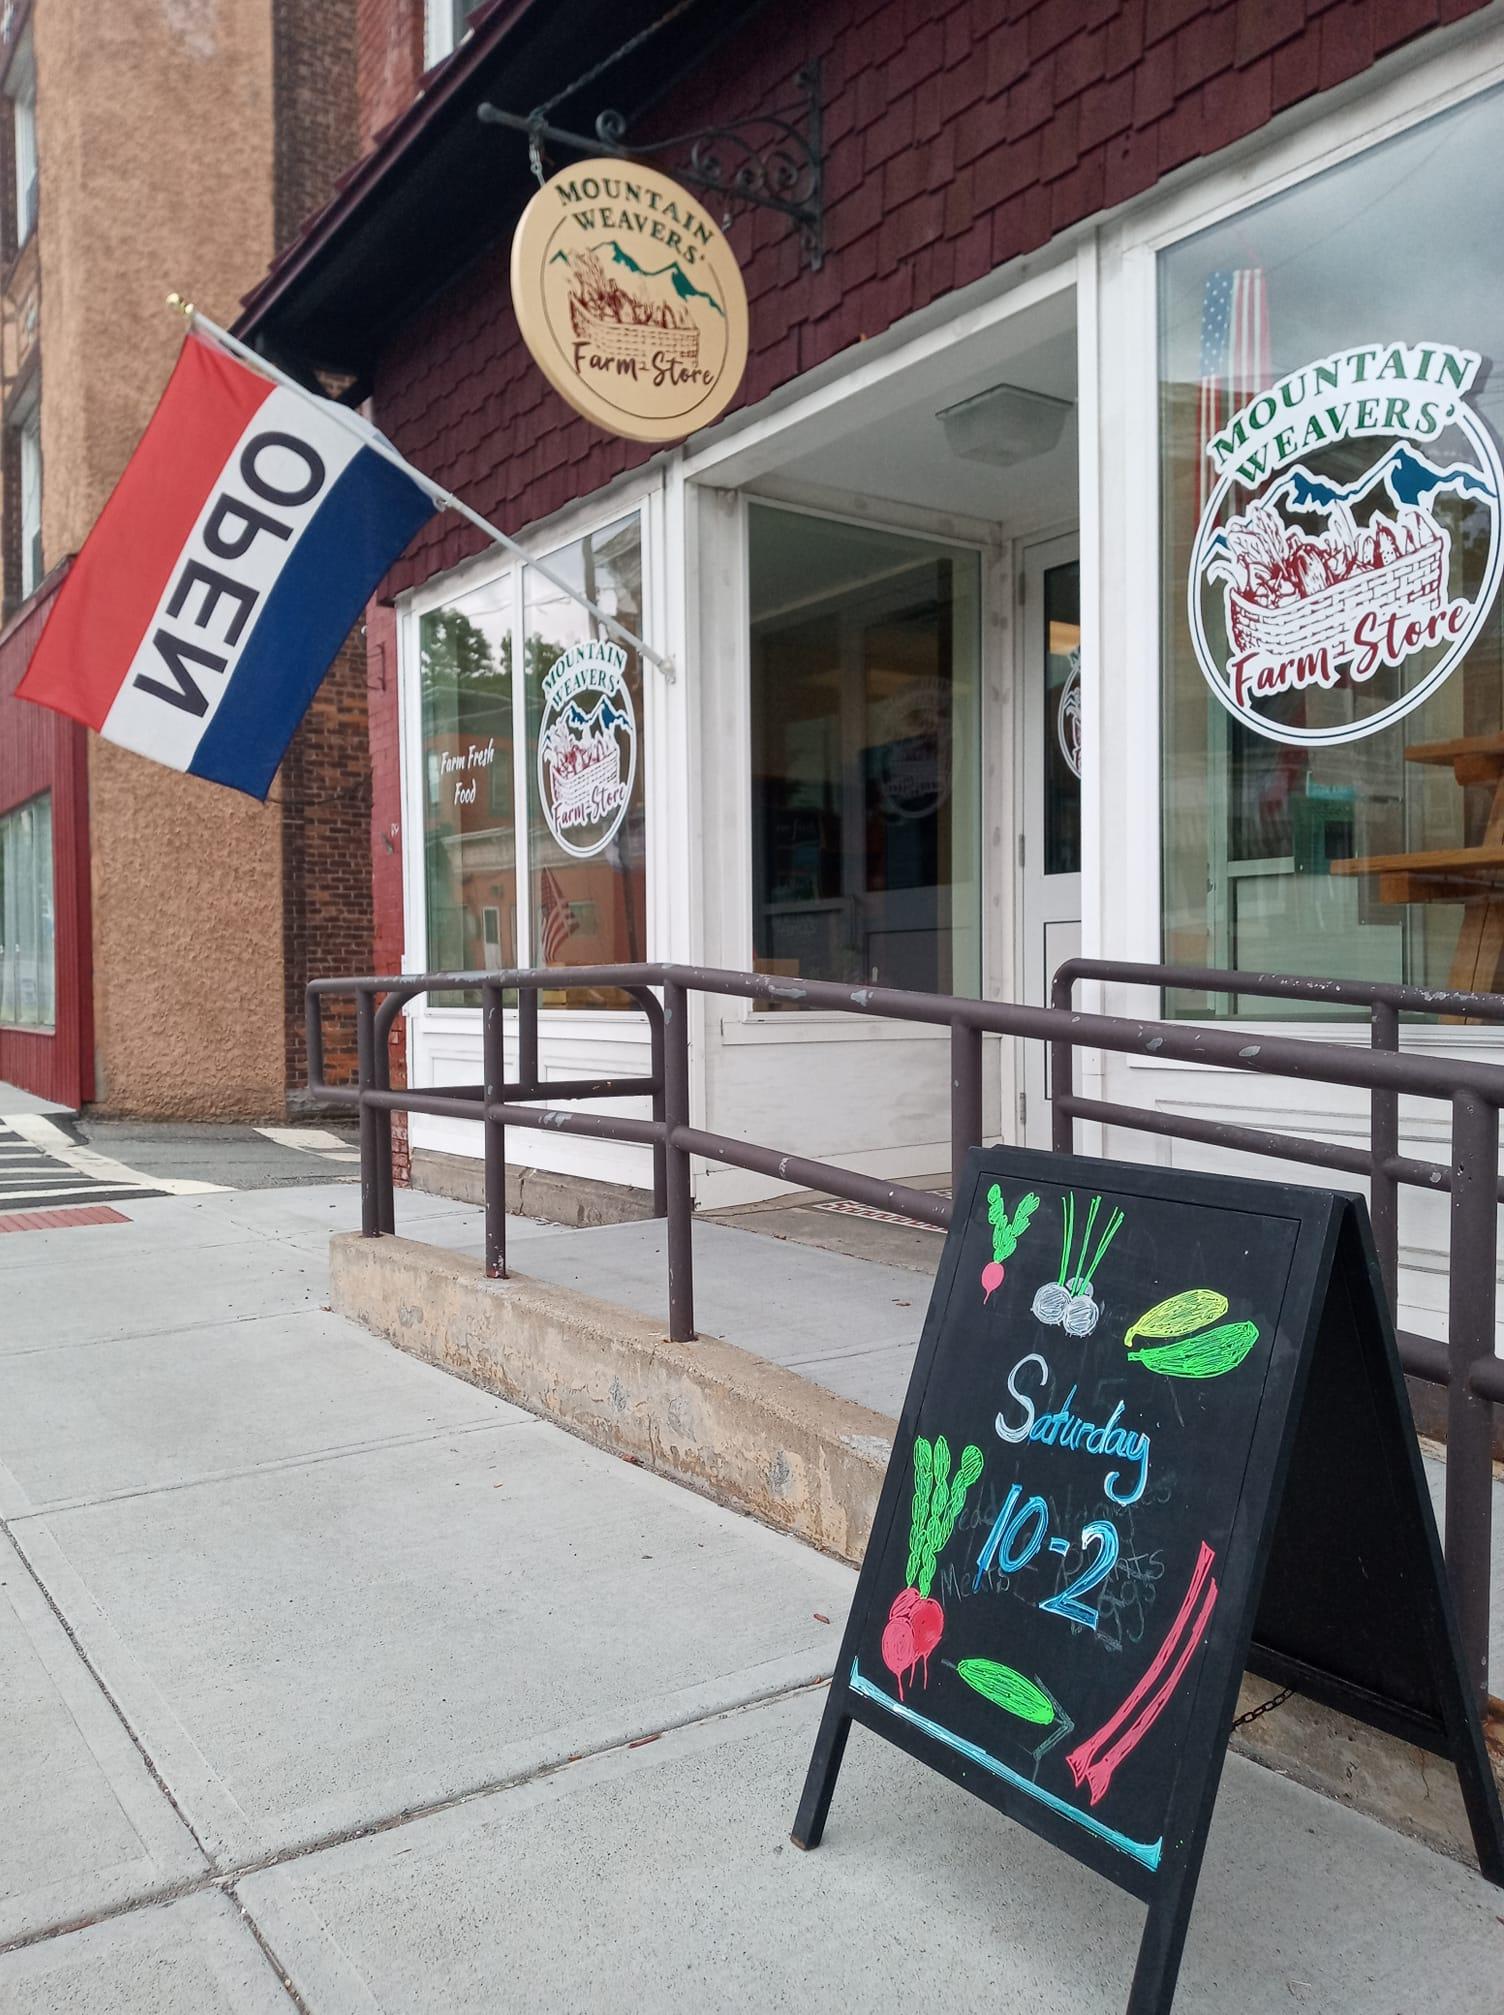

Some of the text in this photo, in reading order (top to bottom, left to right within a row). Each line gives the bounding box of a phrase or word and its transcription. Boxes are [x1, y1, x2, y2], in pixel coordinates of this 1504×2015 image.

[555, 177, 714, 245] MOUNTAIN
[572, 340, 715, 387] Farm Store
[1211, 348, 1475, 467] MOUNTAIN
[1235, 397, 1457, 484] WEAVERS'
[544, 643, 625, 694] MOUNTAIN
[1231, 605, 1471, 708] Farm Store
[440, 737, 495, 775] Farm Fresh
[454, 778, 477, 806] Food
[554, 786, 624, 833] Farm Store
[995, 1353, 1151, 1507] Saturday
[972, 1483, 1119, 1631] 10-2
